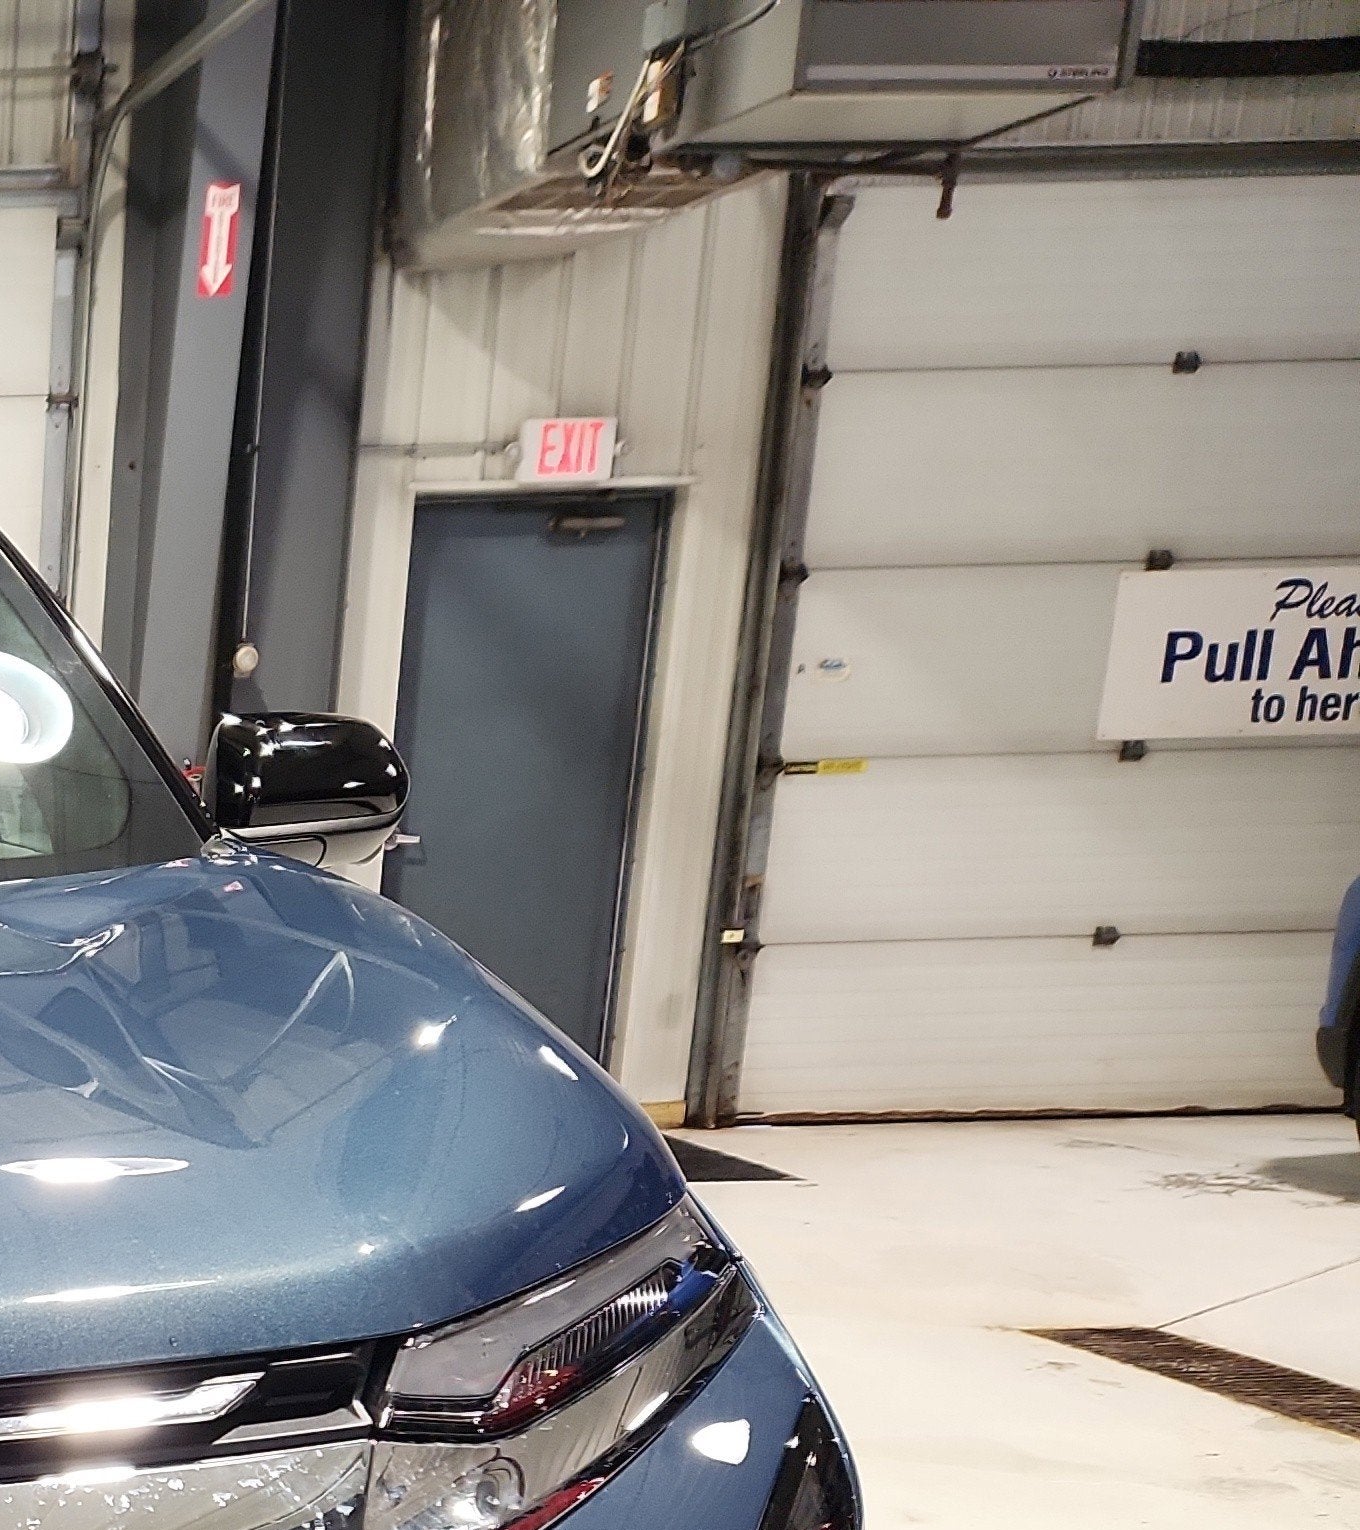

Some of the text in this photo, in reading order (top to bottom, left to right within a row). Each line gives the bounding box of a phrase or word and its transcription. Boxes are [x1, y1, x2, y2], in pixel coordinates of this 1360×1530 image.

[537, 421, 605, 475] EXIT
[1160, 629, 1275, 683] Pull
[1251, 687, 1286, 723] to
